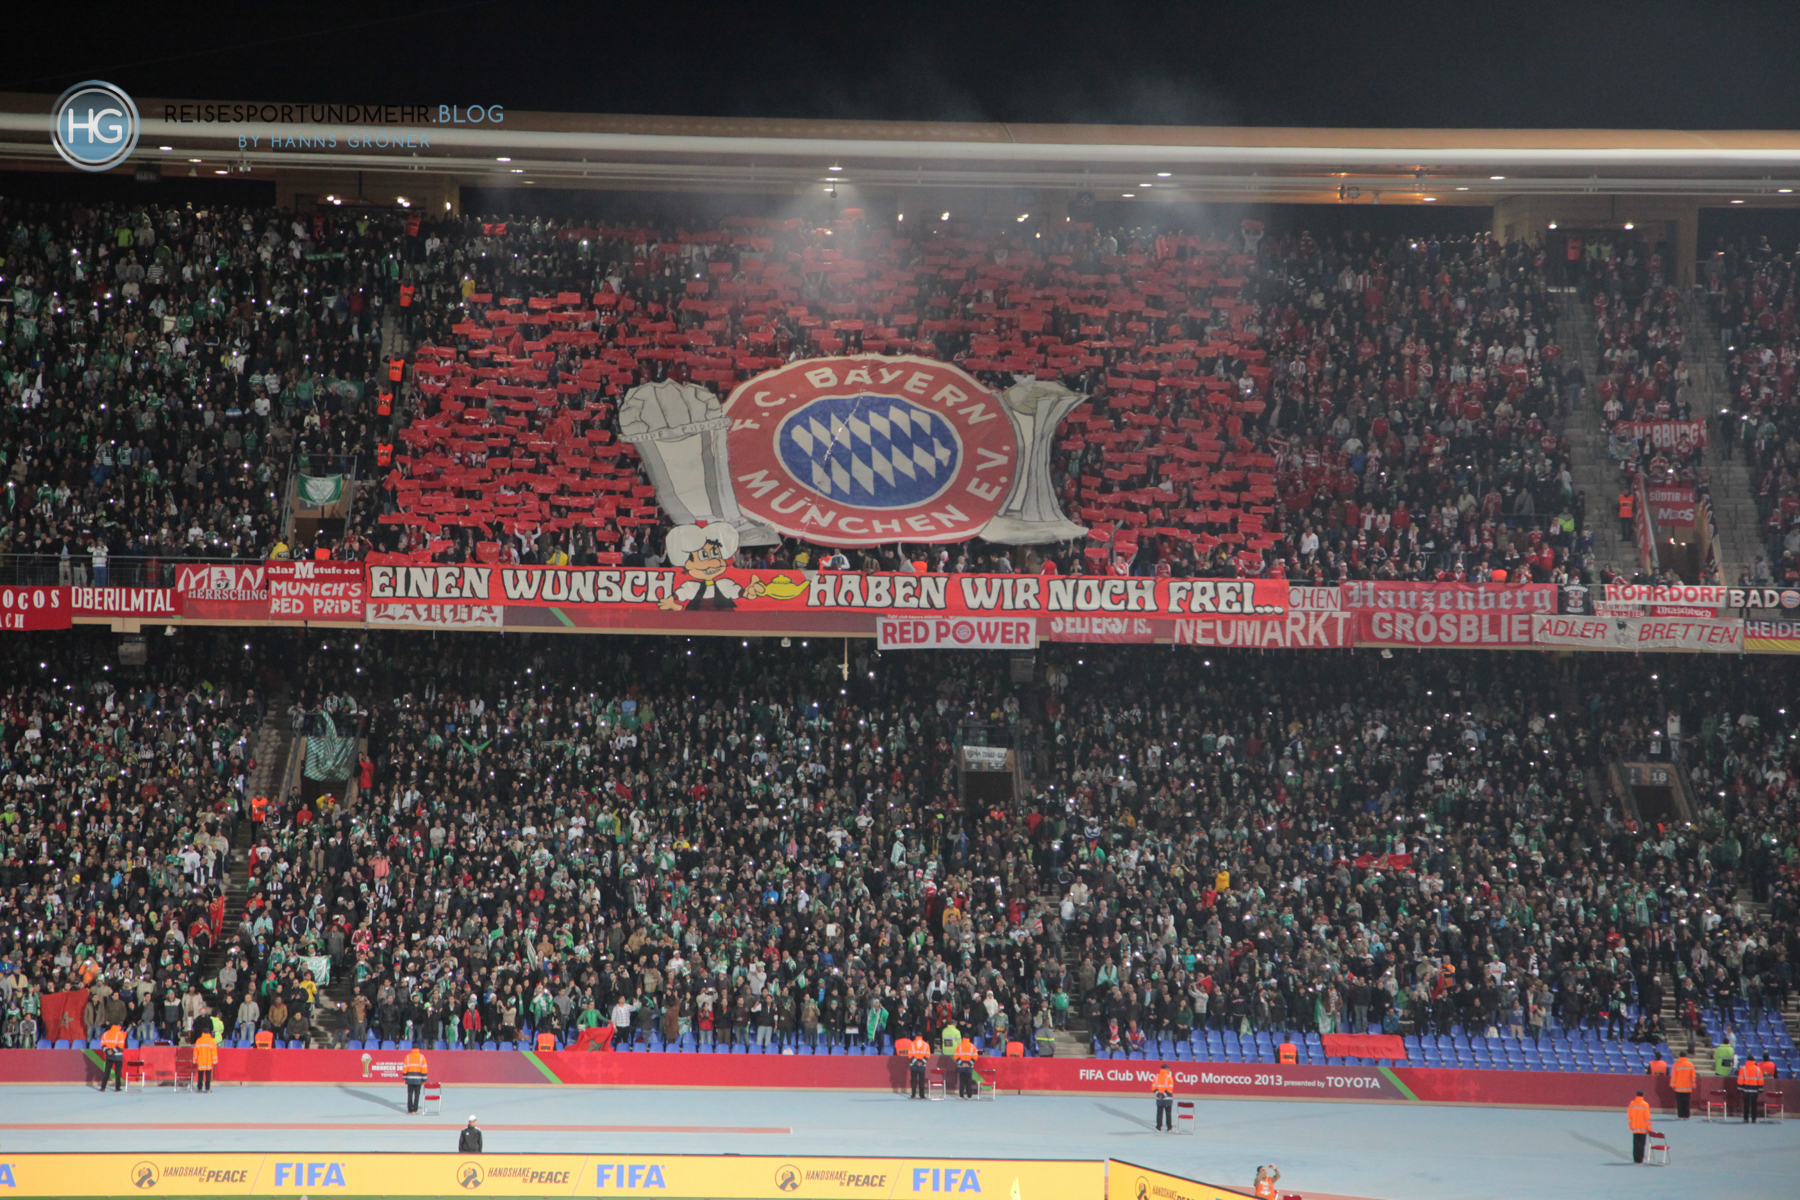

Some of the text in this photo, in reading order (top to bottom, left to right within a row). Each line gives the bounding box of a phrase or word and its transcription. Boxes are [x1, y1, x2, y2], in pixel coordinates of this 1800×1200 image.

[804, 366, 996, 426] BAYERN
[738, 469, 971, 535] MÜNCHEN
[344, 566, 361, 575] rot
[188, 588, 268, 601] HERRSCHING
[369, 565, 492, 599] EINEN
[501, 568, 675, 603] WUNSCH
[806, 573, 950, 609] HABEN
[961, 576, 1041, 610] WIR
[1047, 578, 1158, 612] NOCH
[1345, 581, 1552, 614] Hauzenberg
[1606, 584, 1726, 603] ROHRDORF
[1728, 589, 1780, 608] BAD
[270, 598, 305, 614] RED
[882, 620, 1031, 645] RED POWER
[1174, 611, 1351, 647] NEUMARKT
[1538, 619, 1742, 644] ADLER BRETTEN
[1651, 772, 1667, 781] 18
[1079, 1069, 1105, 1081] FIFA
[1107, 1069, 1134, 1082] Club
[1175, 1071, 1198, 1086] Cup
[1201, 1073, 1252, 1085] Morocco
[1254, 1074, 1283, 1086] 2013
[1284, 1078, 1317, 1088] presented
[1317, 1079, 1326, 1089] by
[1325, 1076, 1380, 1089] TOYOTA
[206, 1169, 248, 1184] PEACE
[274, 1162, 346, 1187] FIFA
[529, 1170, 570, 1185] PEACE
[596, 1164, 666, 1189] FIFA
[846, 1173, 886, 1188] PEACE
[912, 1167, 982, 1193] FIFA
